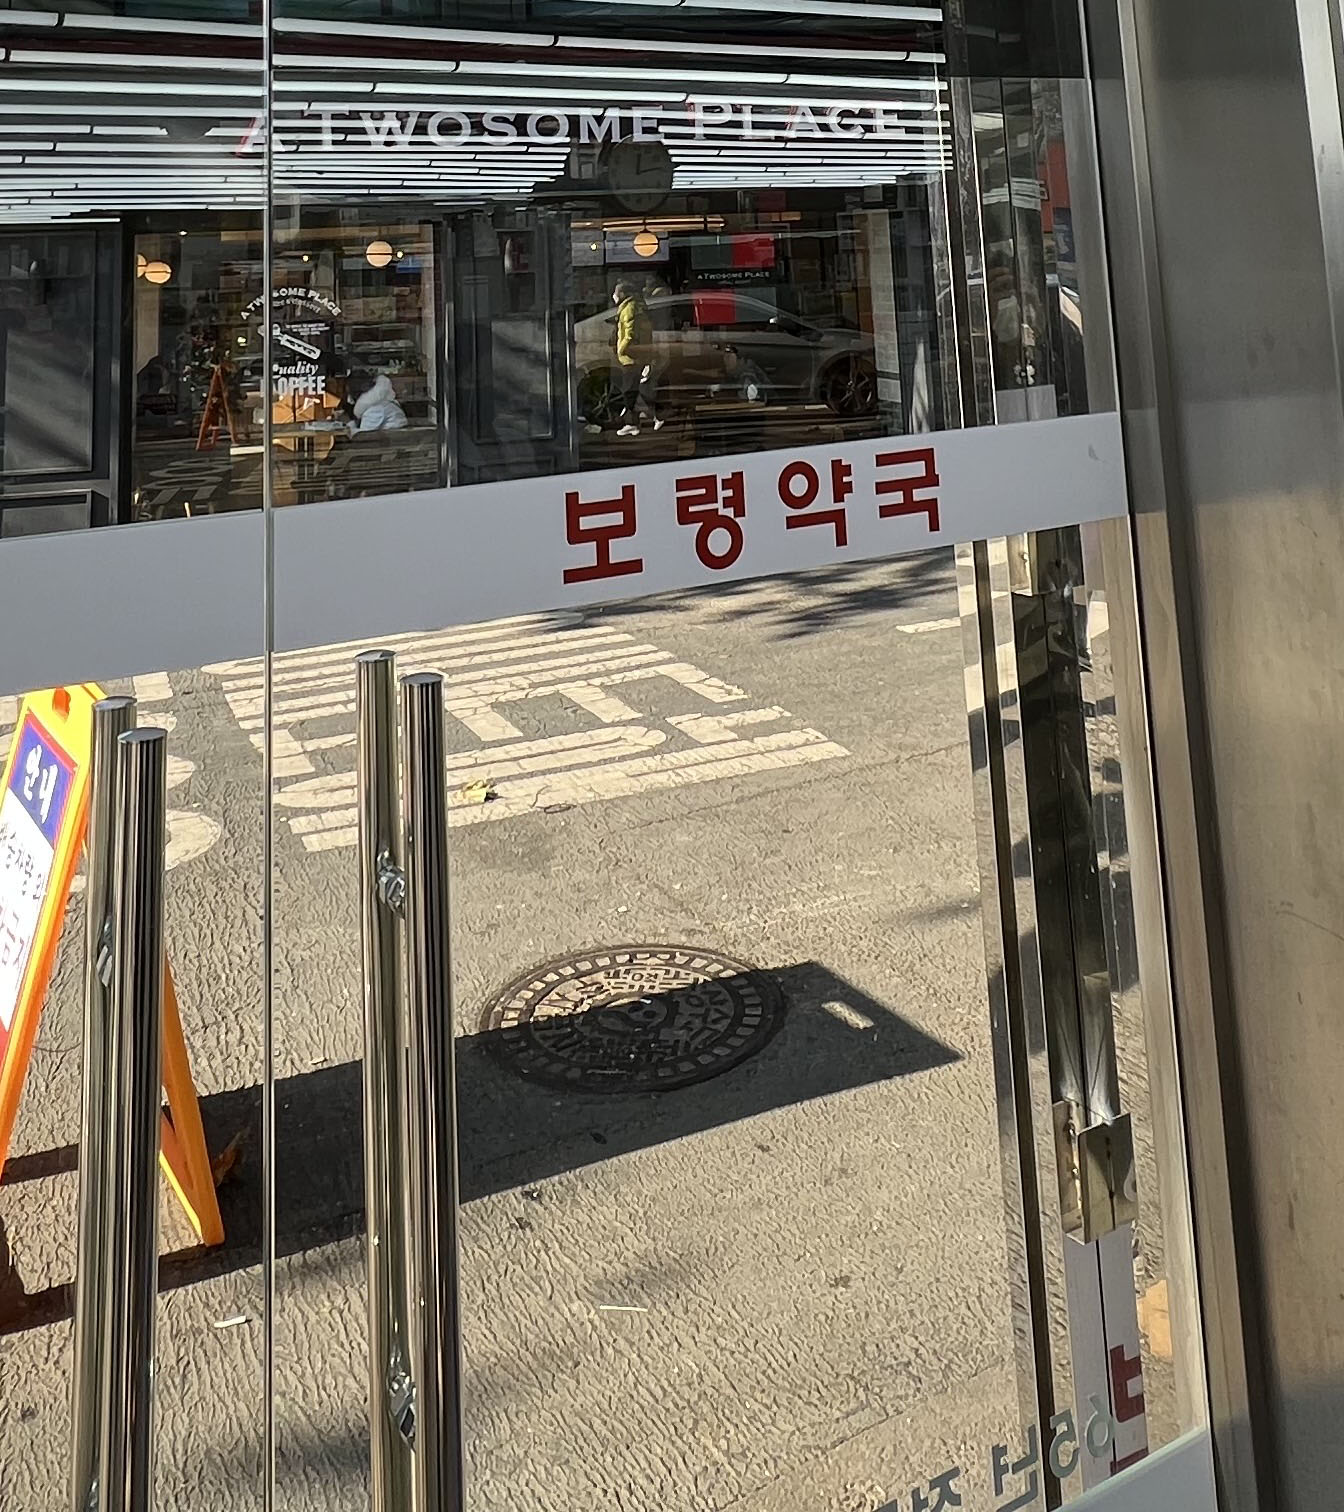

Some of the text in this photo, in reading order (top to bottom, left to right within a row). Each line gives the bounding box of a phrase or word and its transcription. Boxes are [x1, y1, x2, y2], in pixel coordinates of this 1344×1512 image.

[303, 103, 664, 150] TWOSOME
[687, 99, 907, 141] PLACE
[308, 291, 342, 316] PLACE
[563, 447, 942, 584] 보령약국
[24, 744, 58, 824] 안내
